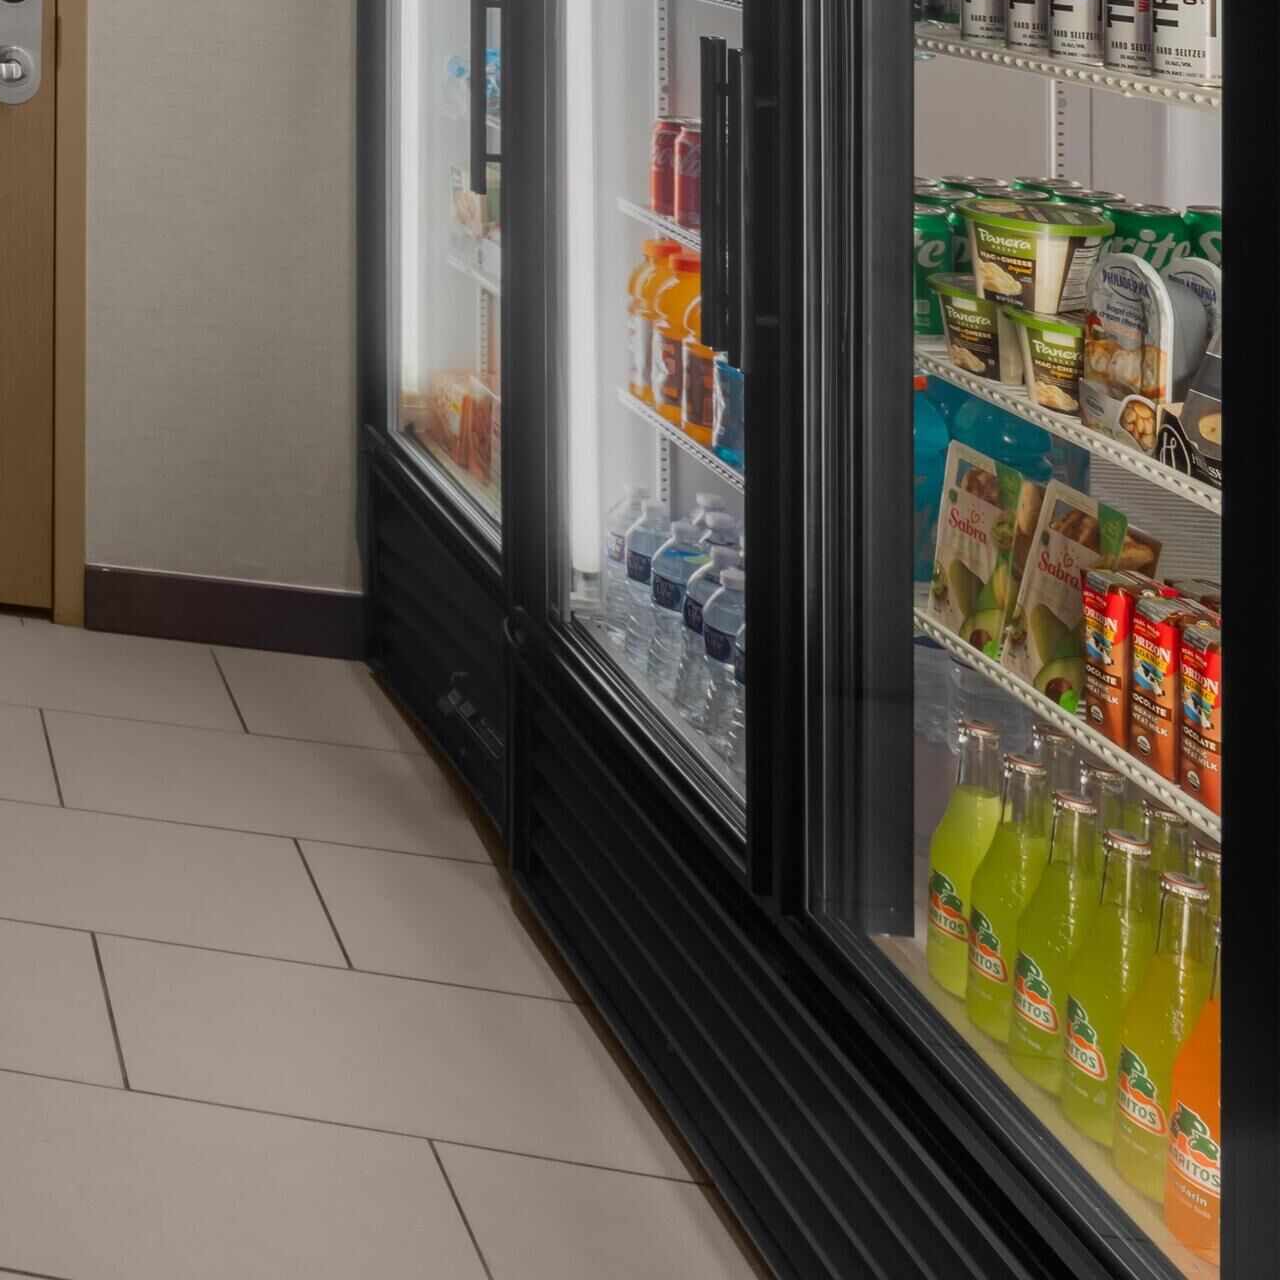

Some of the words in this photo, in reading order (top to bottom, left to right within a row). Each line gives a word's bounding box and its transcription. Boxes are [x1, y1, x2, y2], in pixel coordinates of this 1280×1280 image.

[1176, 48, 1206, 58] SELTZER
[977, 227, 1032, 250] Panera
[945, 305, 992, 326] Panera
[1032, 339, 1081, 361] Paner
[948, 508, 987, 546] Sabra
[1038, 550, 1081, 589] Sabra
[1085, 607, 1118, 633] ORIZON
[1133, 634, 1171, 664] ORIZON
[1182, 664, 1219, 695] ORIZON
[1133, 693, 1167, 717] OCOLATE
[1183, 726, 1216, 751] OCOLATE
